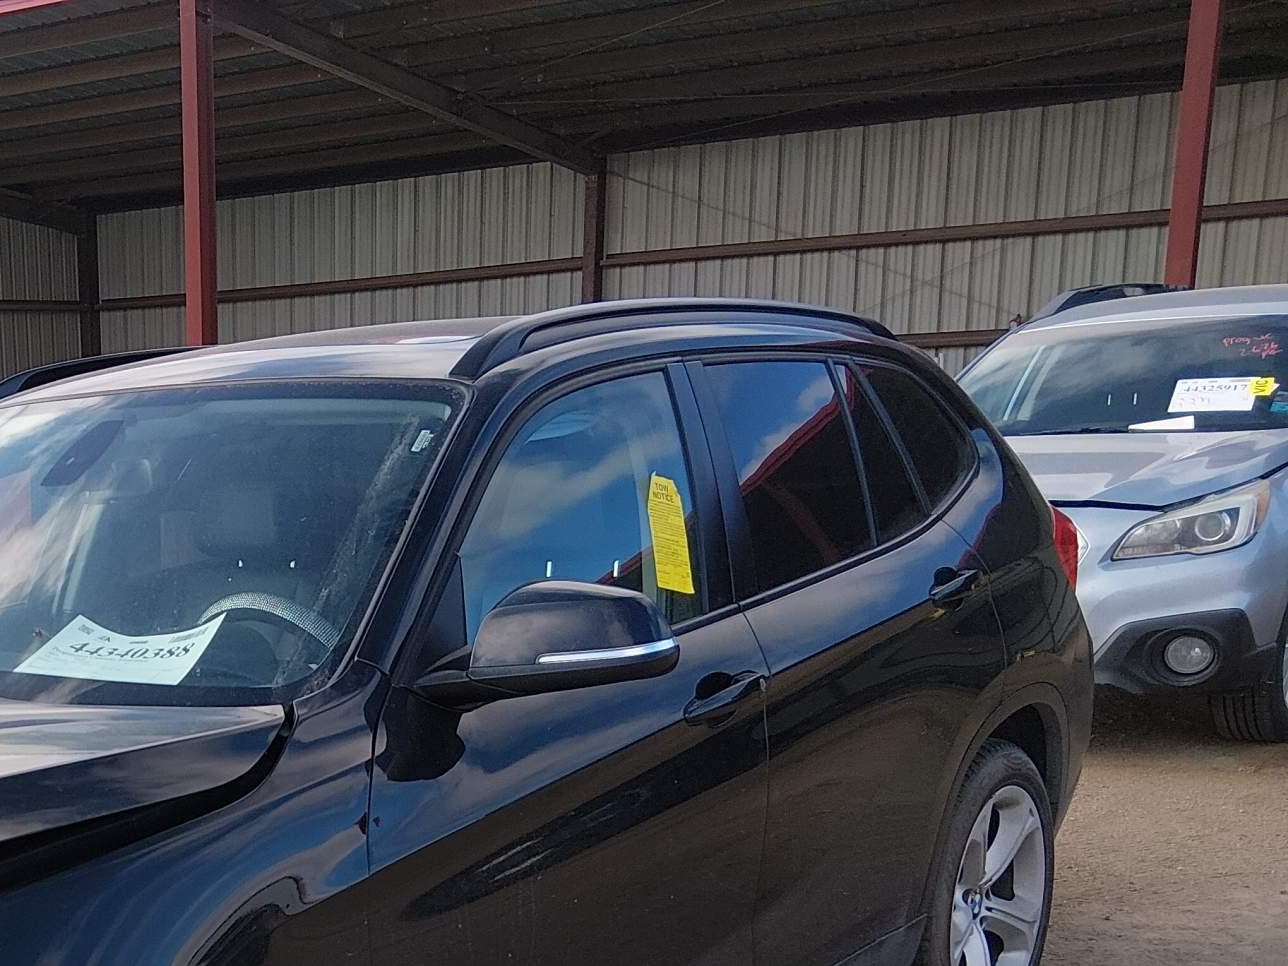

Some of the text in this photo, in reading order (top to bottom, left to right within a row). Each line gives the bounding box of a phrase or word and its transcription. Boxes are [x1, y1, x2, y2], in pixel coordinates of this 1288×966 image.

[1253, 379, 1268, 394] VIC
[655, 482, 669, 493] TOW
[652, 491, 674, 503] NOTICE
[68, 641, 195, 660] 44340388
